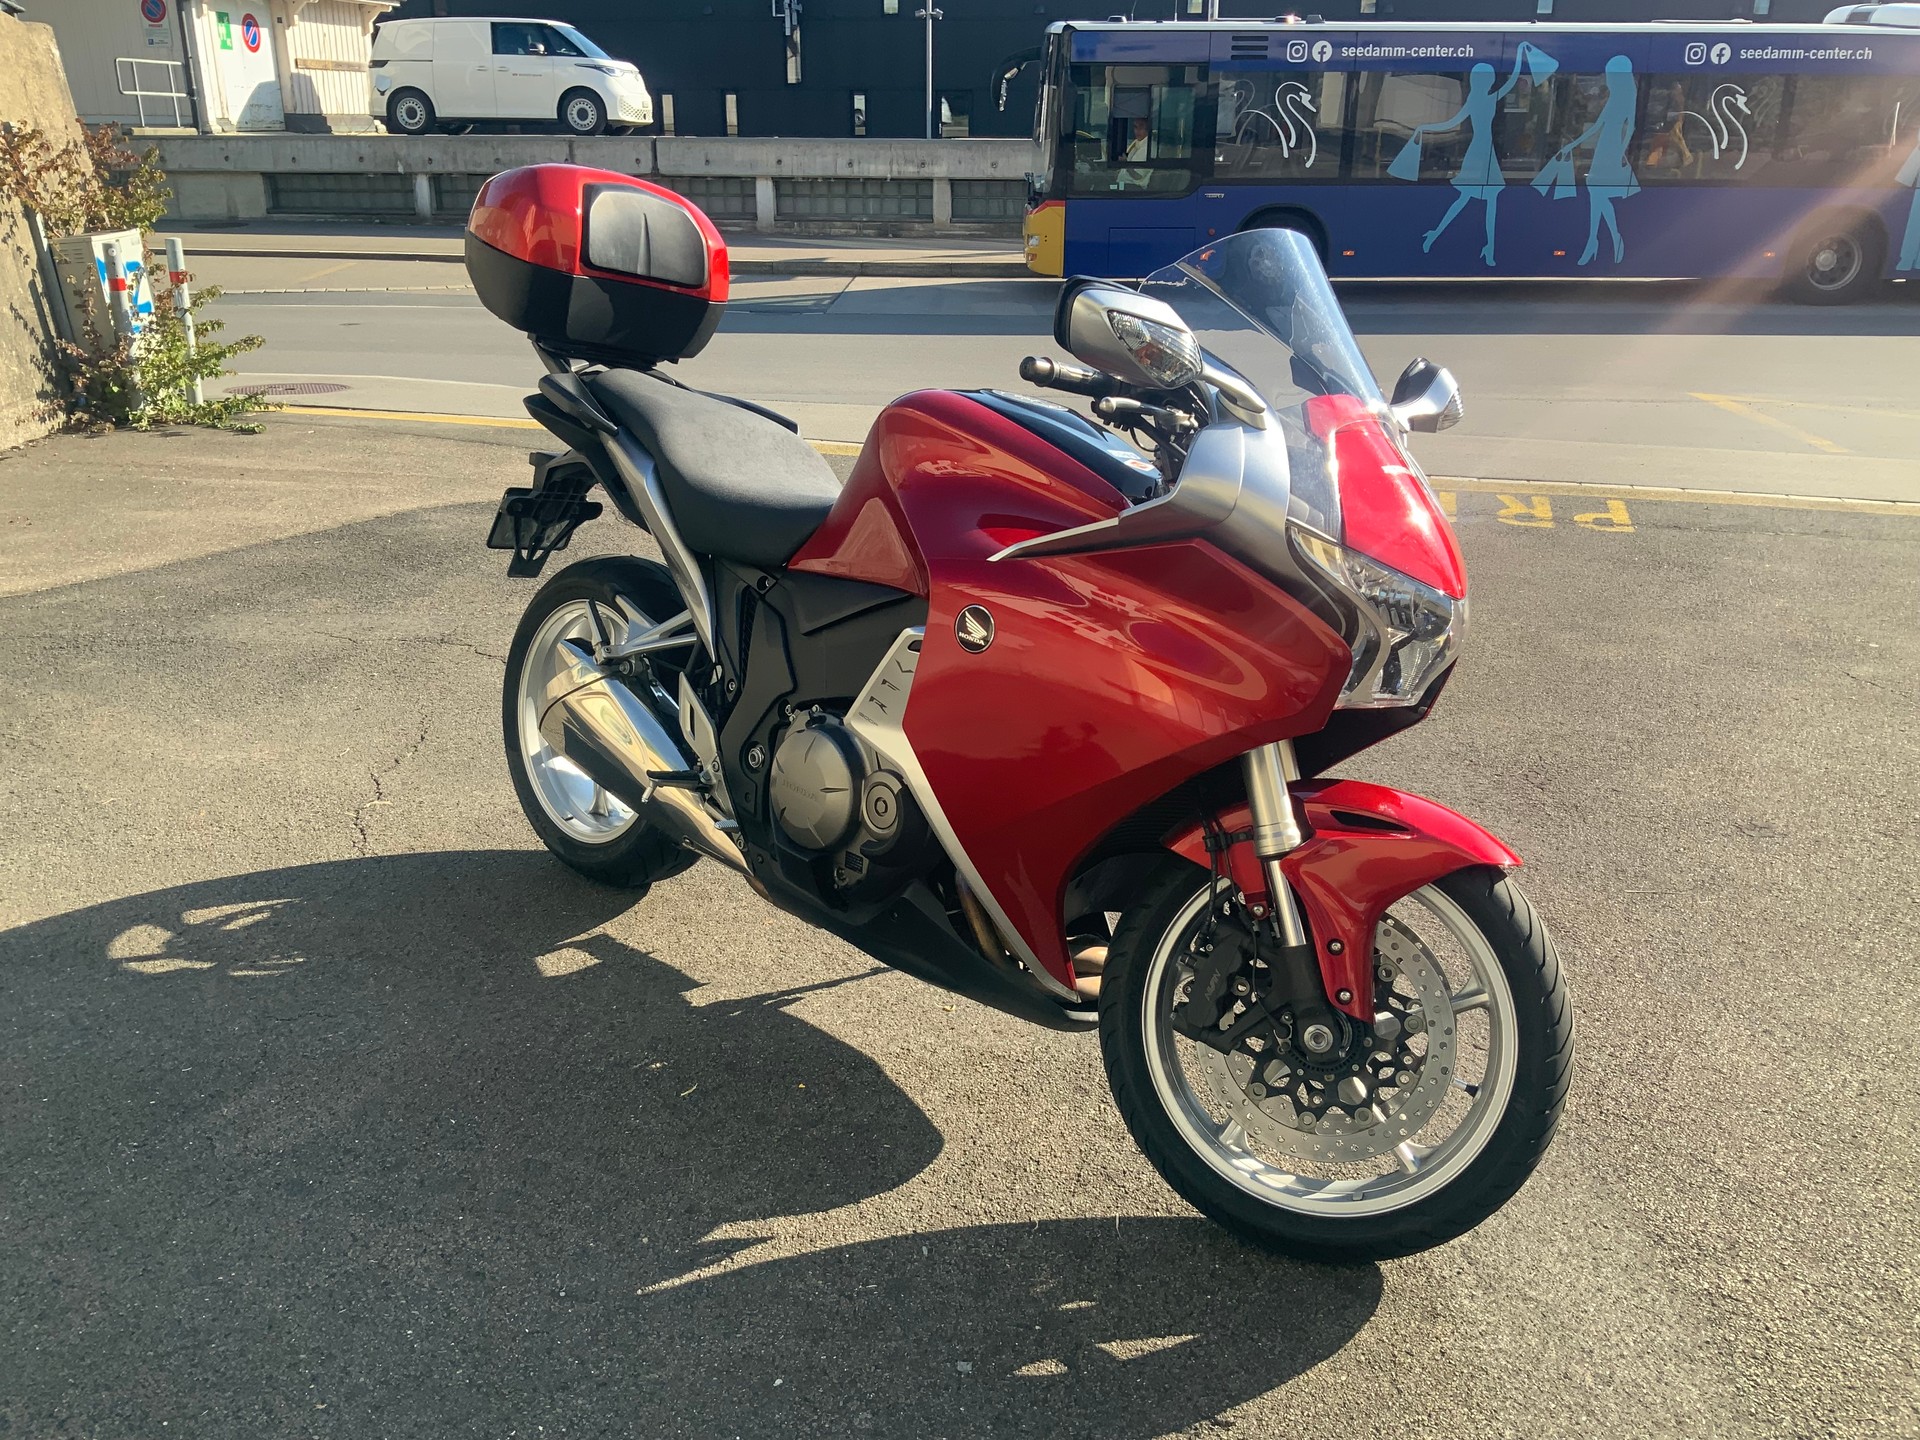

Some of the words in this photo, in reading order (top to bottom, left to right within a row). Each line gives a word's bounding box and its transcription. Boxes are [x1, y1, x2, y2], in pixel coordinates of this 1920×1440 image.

[1341, 43, 1474, 57] seedamm-center.ch
[1740, 46, 1872, 60] seedamm-center.ch
[958, 631, 985, 646] HONDA
